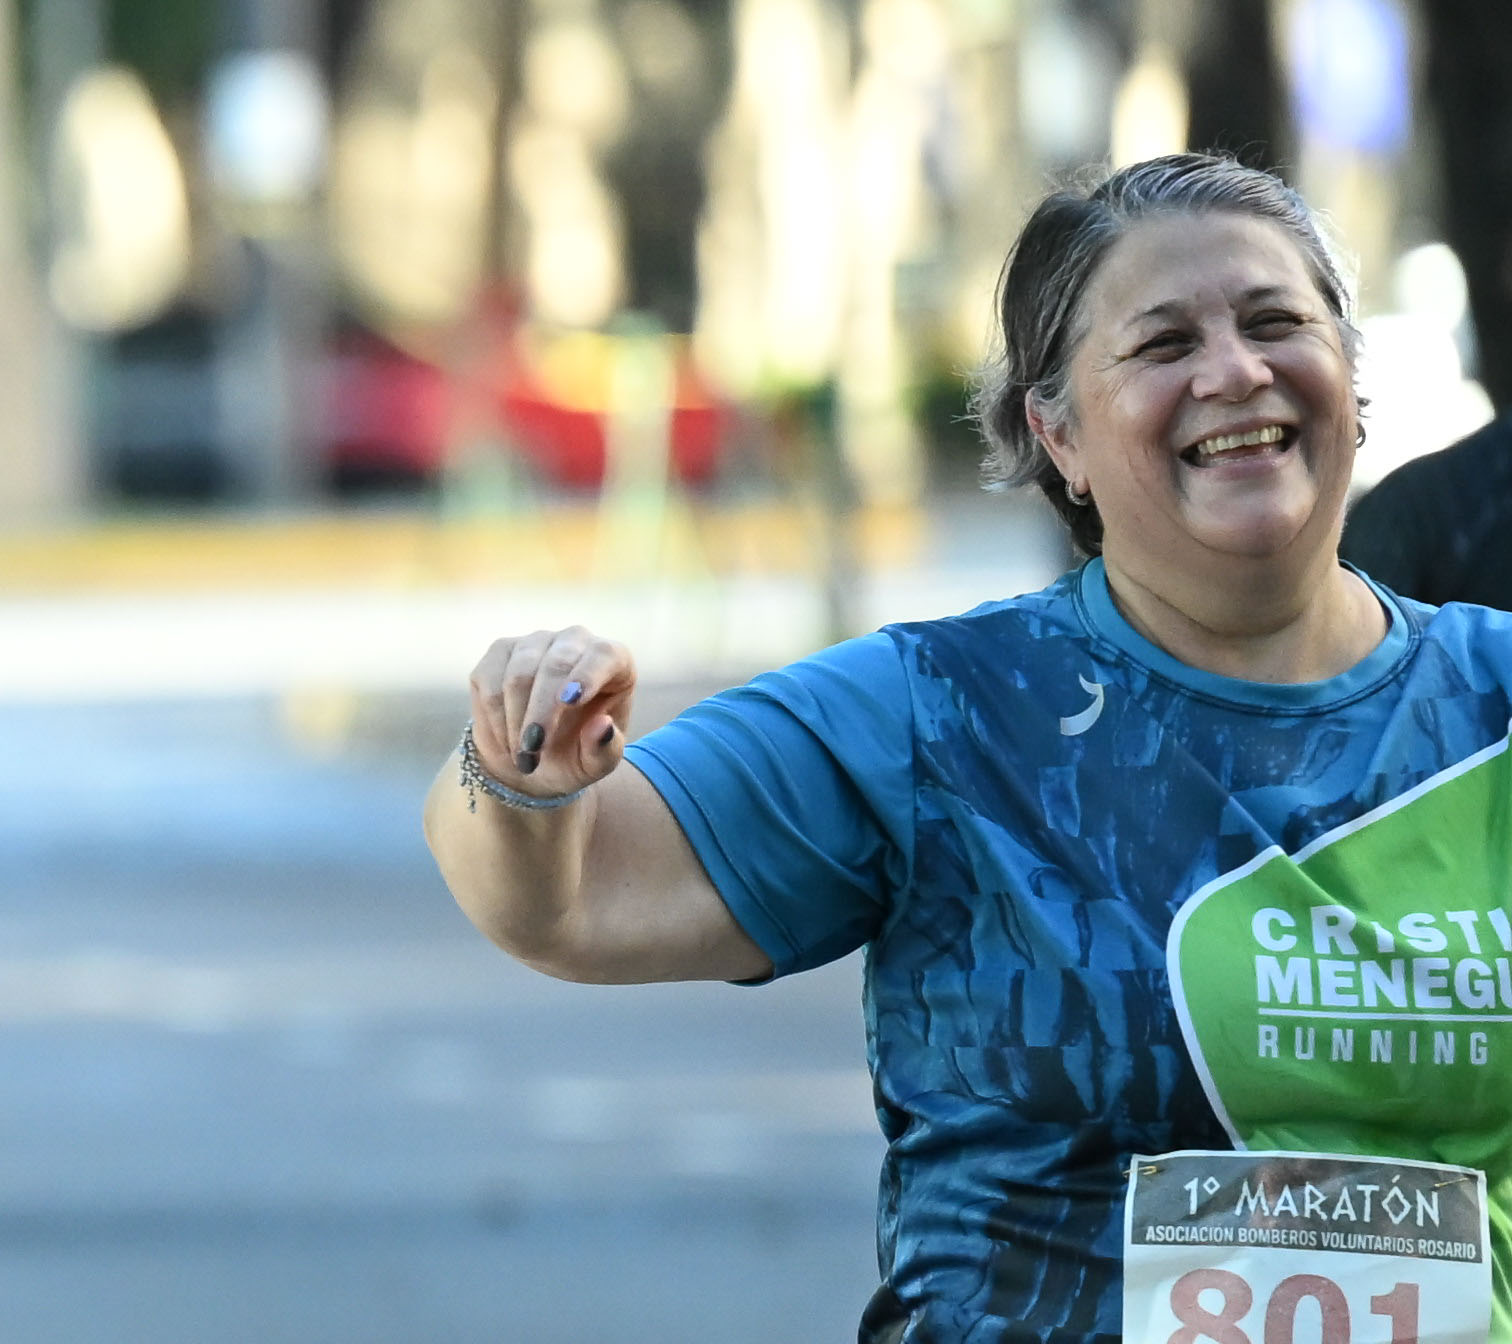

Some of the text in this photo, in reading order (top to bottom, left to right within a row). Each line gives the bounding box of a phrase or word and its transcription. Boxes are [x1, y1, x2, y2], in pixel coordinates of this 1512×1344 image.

[1258, 1024, 1488, 1065] RUNNING
[1234, 1175, 1440, 1228] MARATÓN
[1238, 1227, 1317, 1247] BOMBEROS
[1321, 1231, 1415, 1254] VOLUNTARIOS
[1418, 1238, 1476, 1260] ROSARIO
